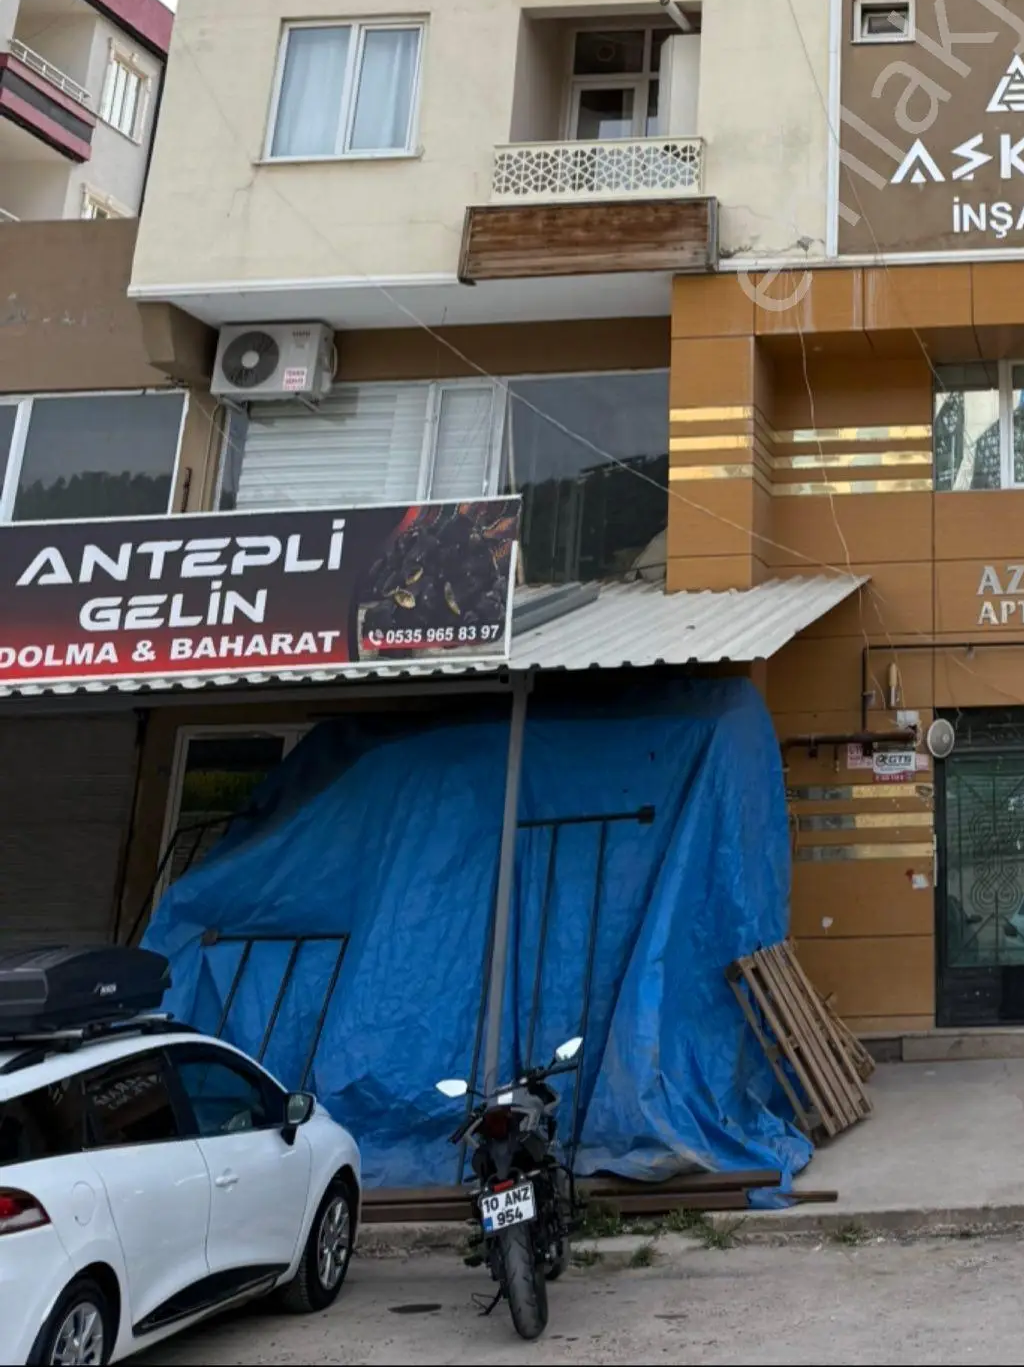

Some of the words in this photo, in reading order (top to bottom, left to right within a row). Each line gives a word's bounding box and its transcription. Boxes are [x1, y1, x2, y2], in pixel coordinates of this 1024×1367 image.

[15, 519, 346, 587] ANTEPLİ
[78, 580, 268, 632] GELİN
[131, 640, 157, 662] &
[170, 631, 340, 660] BAHARAT
[386, 629, 422, 644] 0535
[426, 627, 454, 642] 965
[458, 625, 476, 640] 83
[481, 623, 499, 639] 97
[483, 1197, 499, 1213] 10
[505, 1186, 530, 1207] ANZ
[497, 1206, 523, 1226] 954
